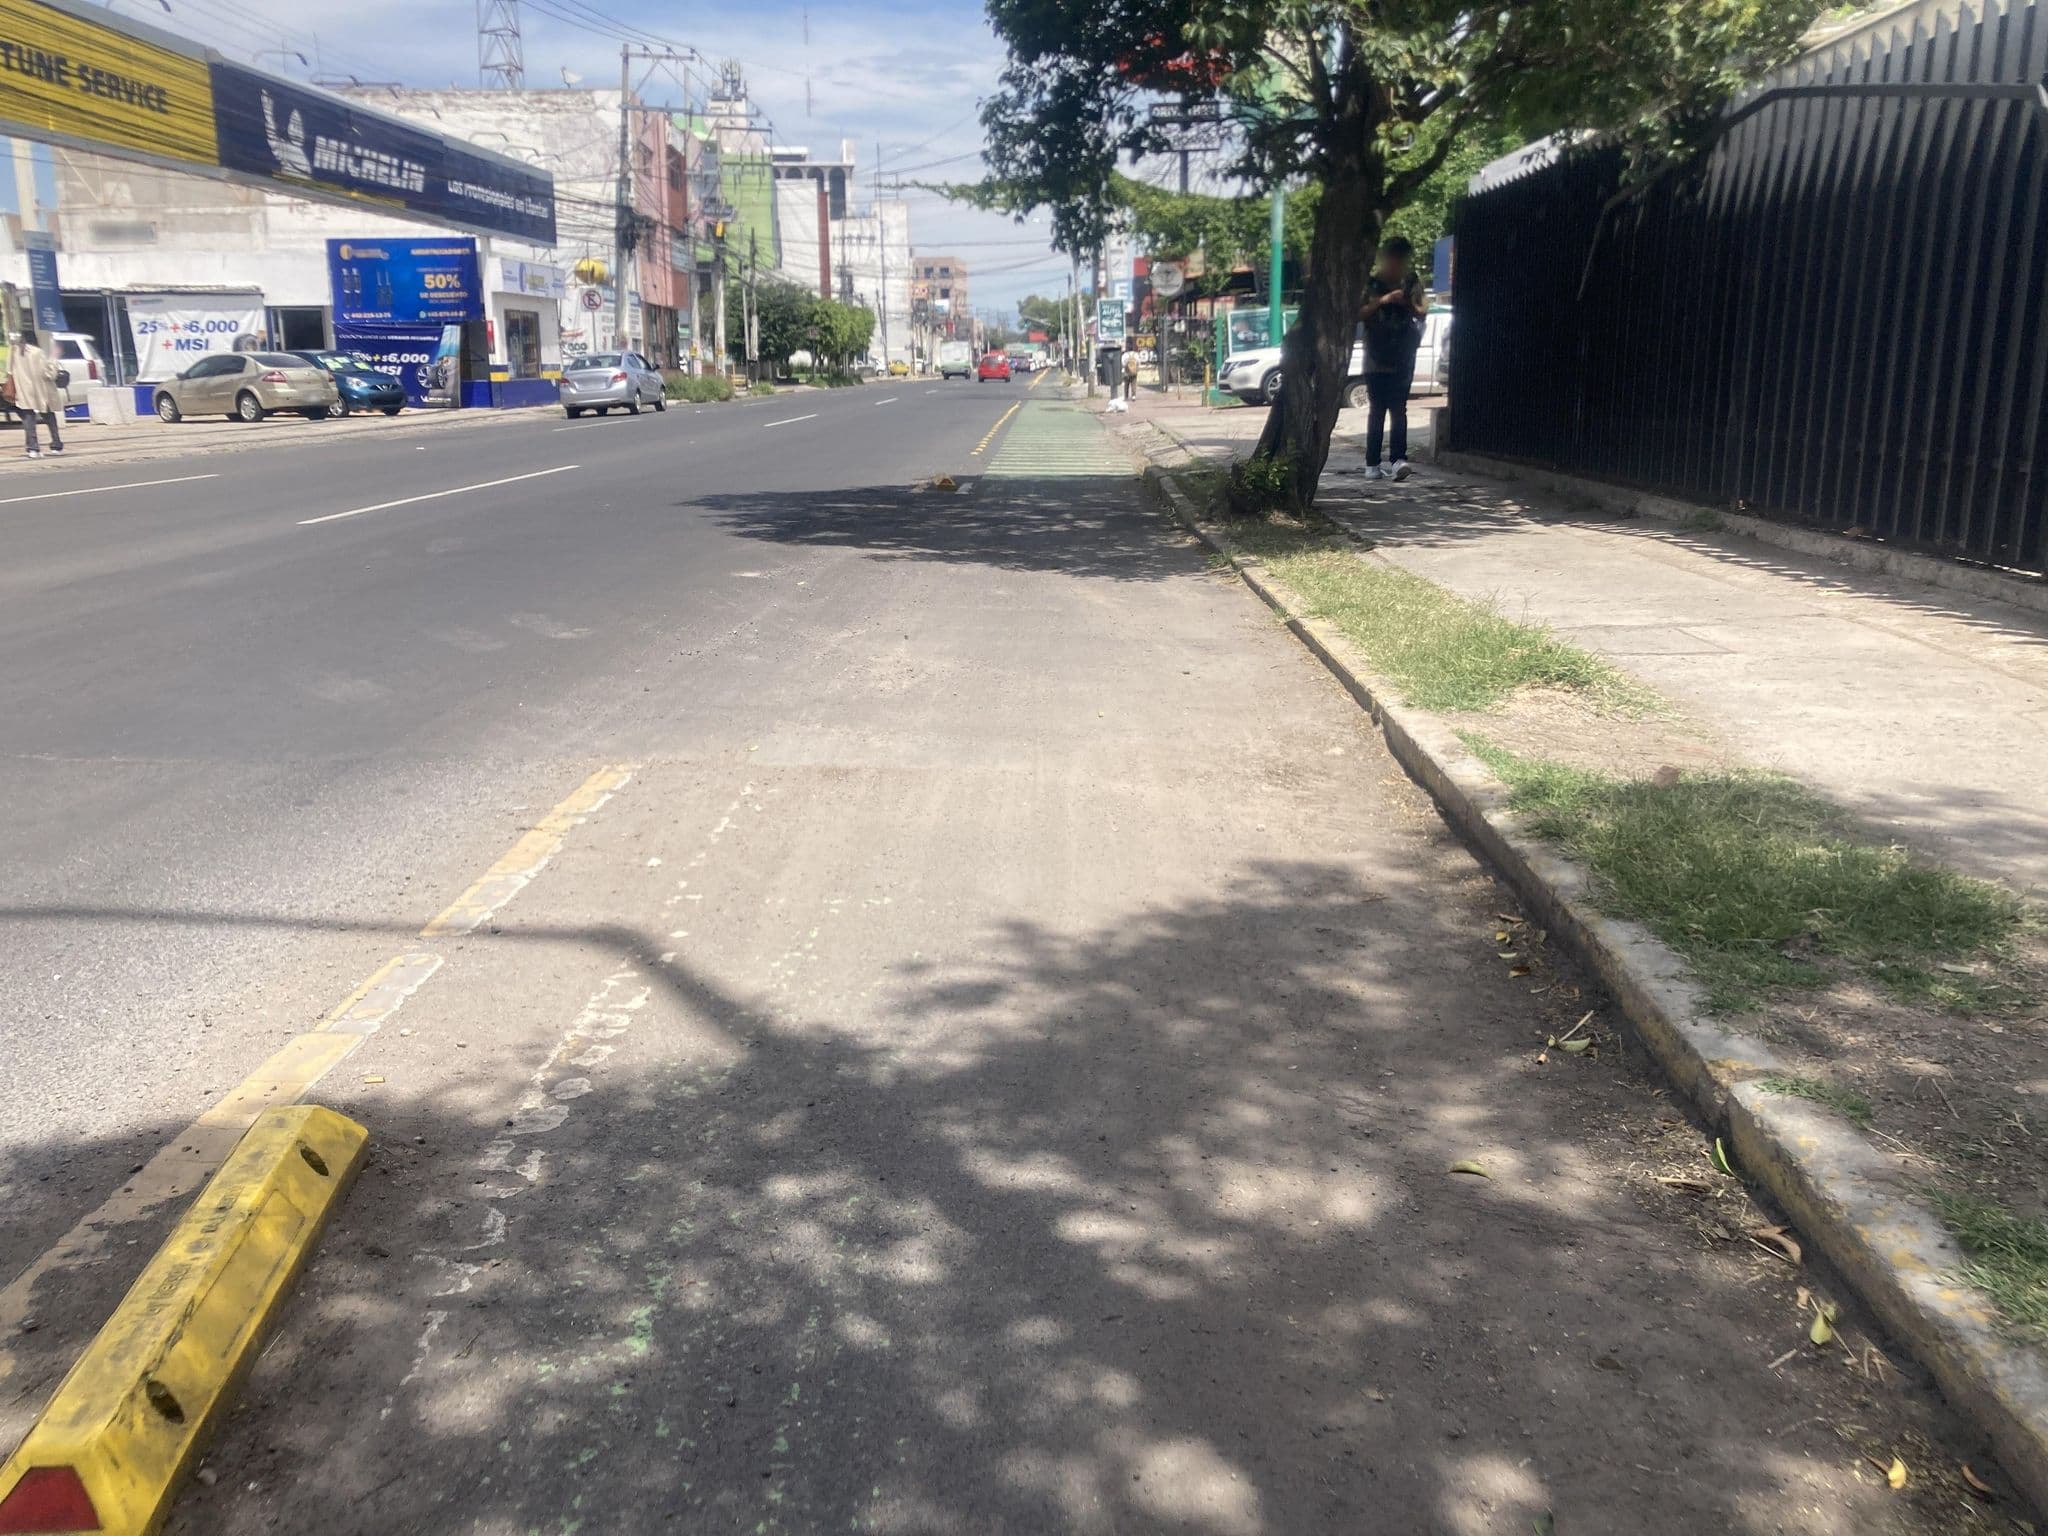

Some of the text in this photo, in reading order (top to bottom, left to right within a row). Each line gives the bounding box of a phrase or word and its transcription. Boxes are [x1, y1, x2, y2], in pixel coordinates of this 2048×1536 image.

[0, 40, 169, 114] TUNE SERVICE
[313, 135, 426, 193] MICHELIN
[424, 273, 461, 289] 50%
[175, 338, 209, 351] MSI
